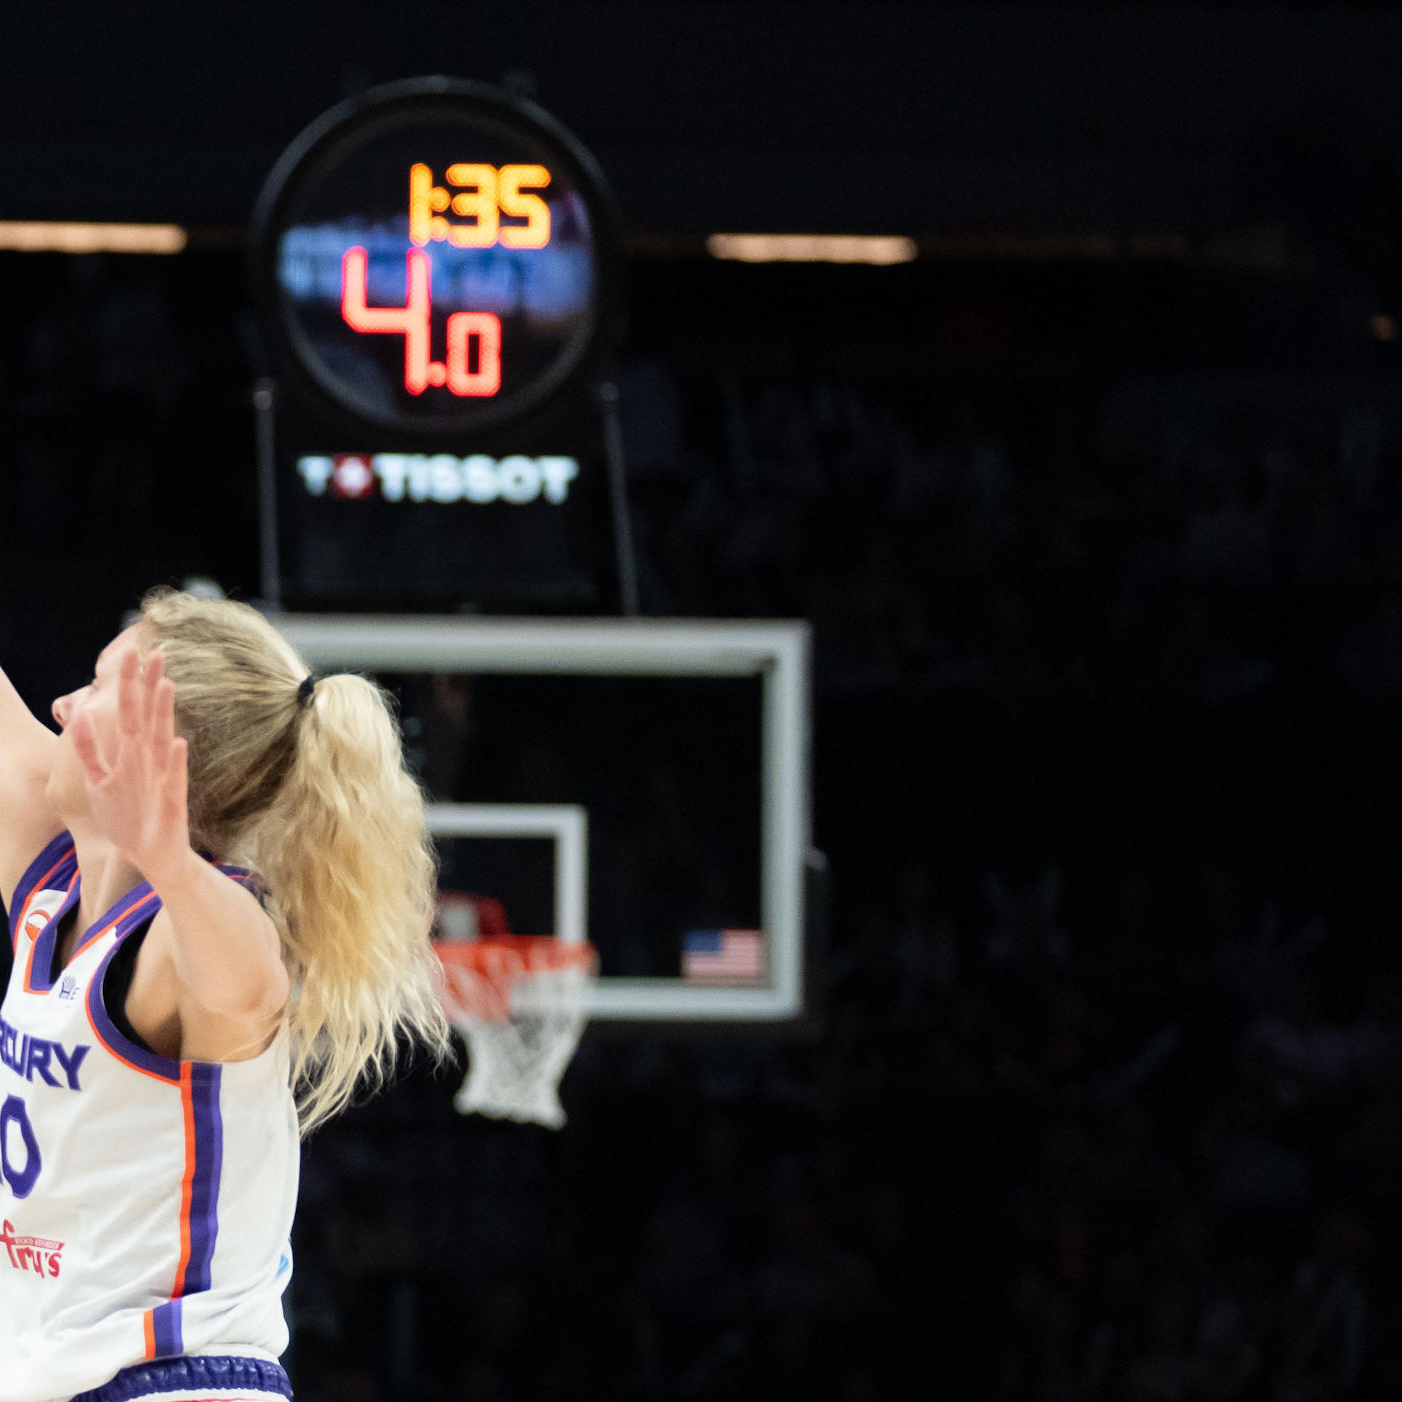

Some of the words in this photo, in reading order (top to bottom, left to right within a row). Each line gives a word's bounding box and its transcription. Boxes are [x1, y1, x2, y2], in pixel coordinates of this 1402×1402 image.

[410, 162, 552, 249] 1:35
[341, 246, 502, 397] 4.0
[372, 453, 580, 505] TISSOT
